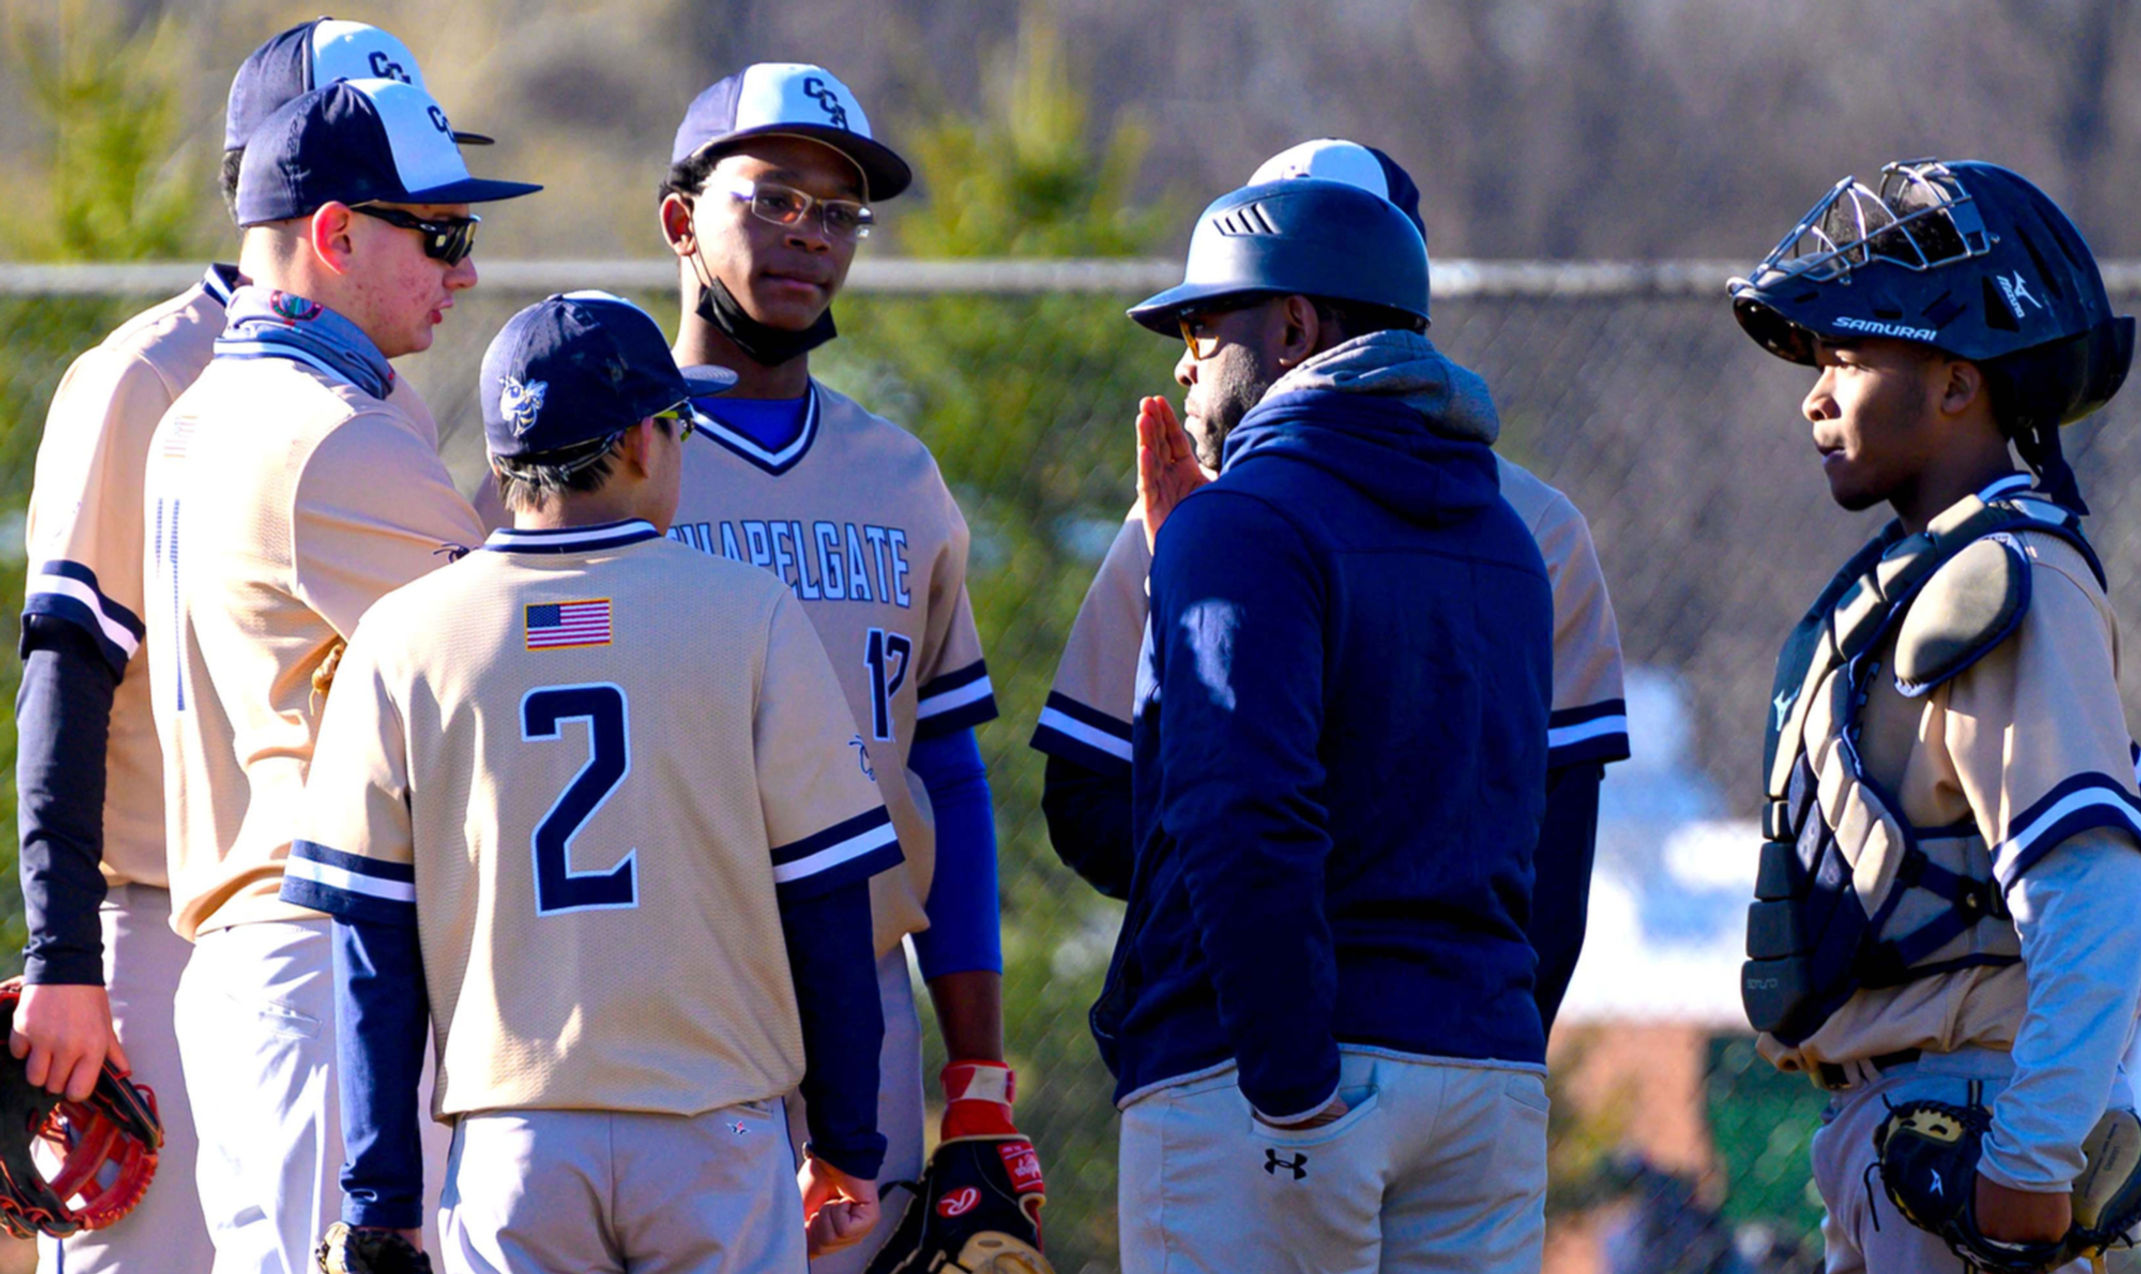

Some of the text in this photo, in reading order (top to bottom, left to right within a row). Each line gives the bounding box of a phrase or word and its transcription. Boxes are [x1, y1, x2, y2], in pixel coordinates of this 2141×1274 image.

[803, 77, 849, 131] CCA
[1831, 316, 1937, 341] SAMURAI
[519, 681, 639, 917] 2
